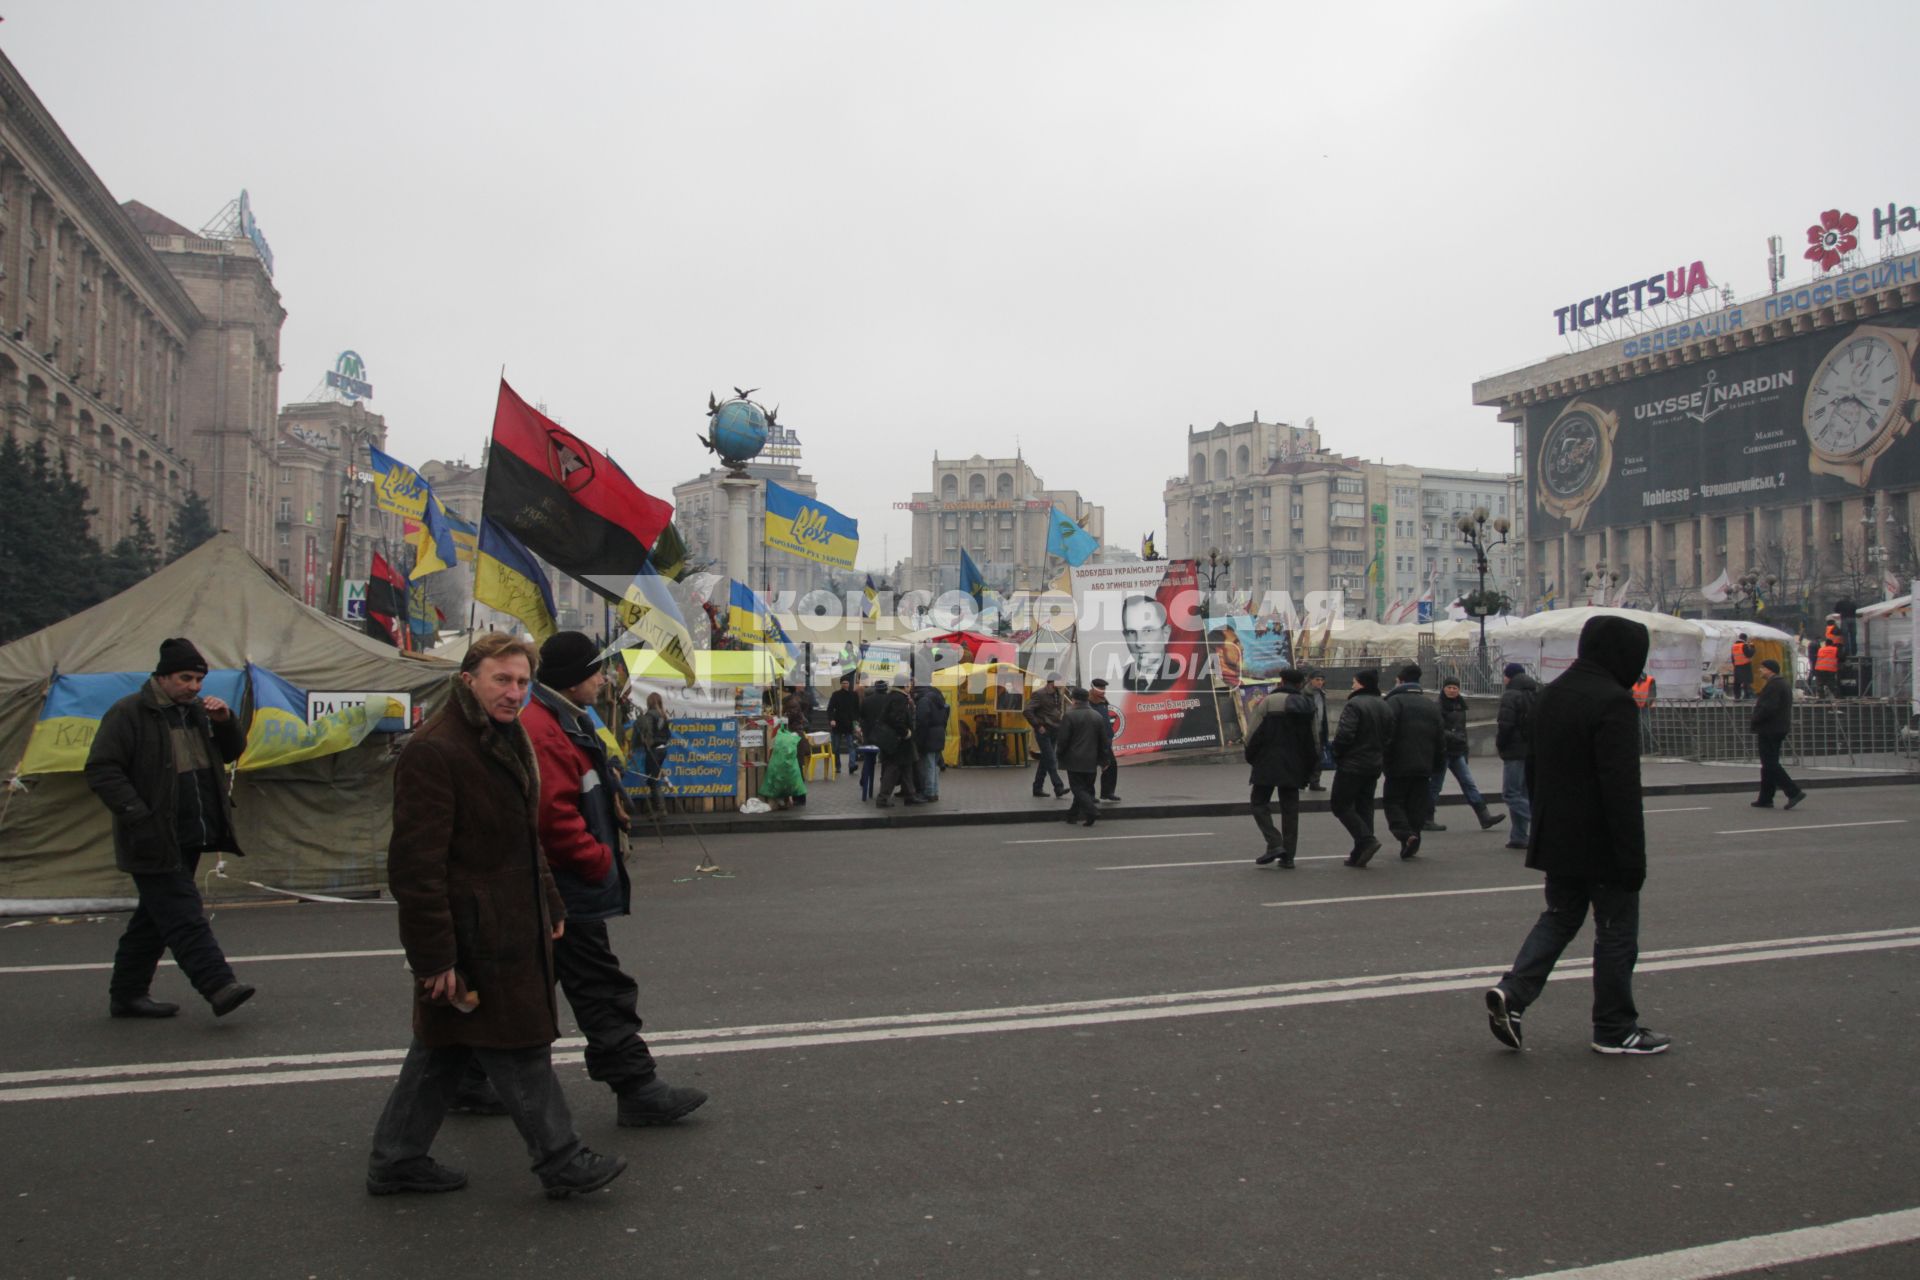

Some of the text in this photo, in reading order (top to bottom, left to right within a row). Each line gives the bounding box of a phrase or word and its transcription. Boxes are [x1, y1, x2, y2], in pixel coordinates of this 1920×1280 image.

[1873, 202, 1920, 240] На
[1623, 255, 1920, 357] ФЕДЕРАЦІЯ ПРОФЕСІЙН
[1634, 391, 1702, 420] ULYSSE
[1714, 370, 1794, 402] NARDIN
[1642, 488, 1690, 507] Noblesse
[1779, 472, 1785, 487] 2
[1075, 567, 1113, 578] ЗДОБУДЕШ
[1114, 565, 1154, 576] УКРАЇНСЬКУ
[1091, 582, 1105, 591] АБО
[1106, 580, 1133, 590] ЗГИНЕШ
[869, 663, 896, 673] НАМЕТ
[1137, 698, 1200, 712] Степан Бандера
[692, 738, 705, 747] до
[1169, 734, 1216, 745] НАЦІОНАЛІСТІВ
[675, 766, 723, 777] Лісабону
[682, 783, 732, 794] УКРАЇНИ
